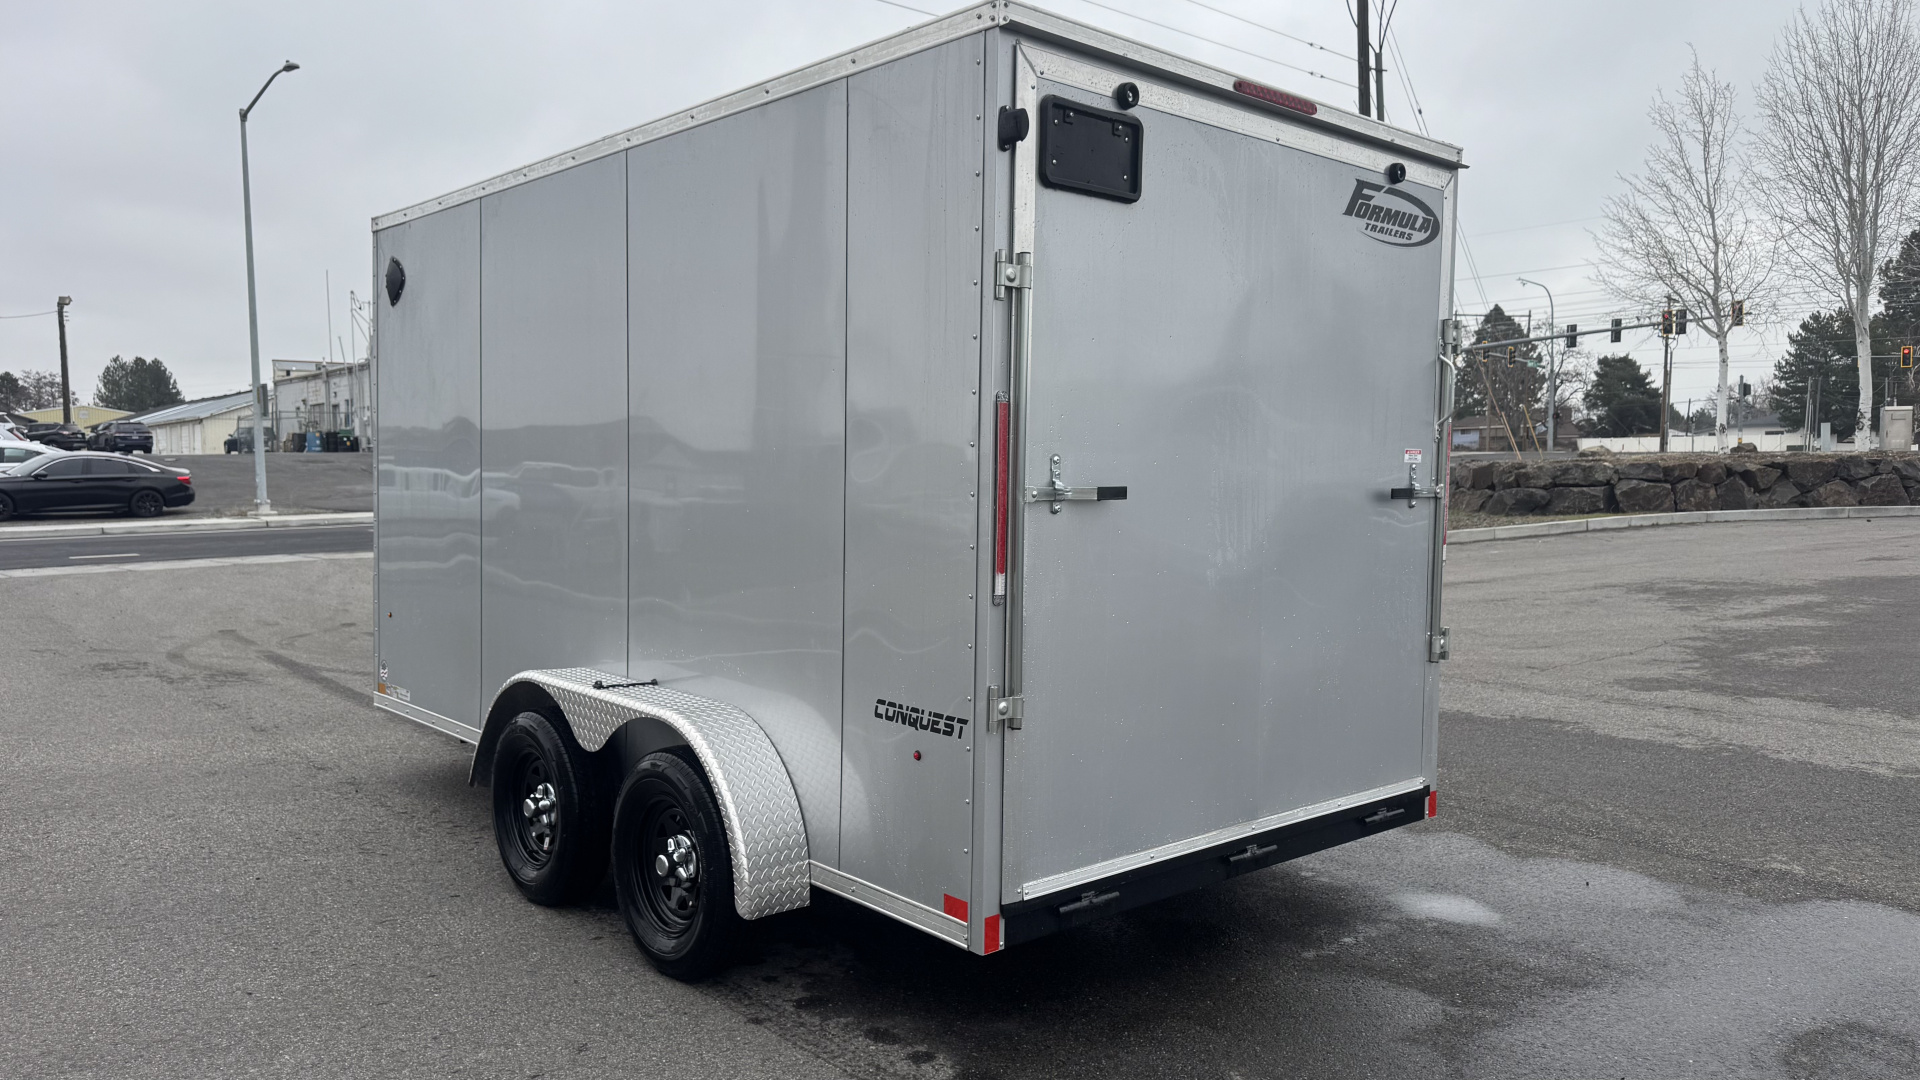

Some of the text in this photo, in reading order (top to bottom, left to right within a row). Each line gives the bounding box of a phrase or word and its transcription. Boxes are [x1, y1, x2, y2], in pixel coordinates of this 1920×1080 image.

[1342, 178, 1433, 234] FORMULA
[1364, 222, 1414, 241] TRAILERS
[874, 698, 969, 739] CONQUEST
